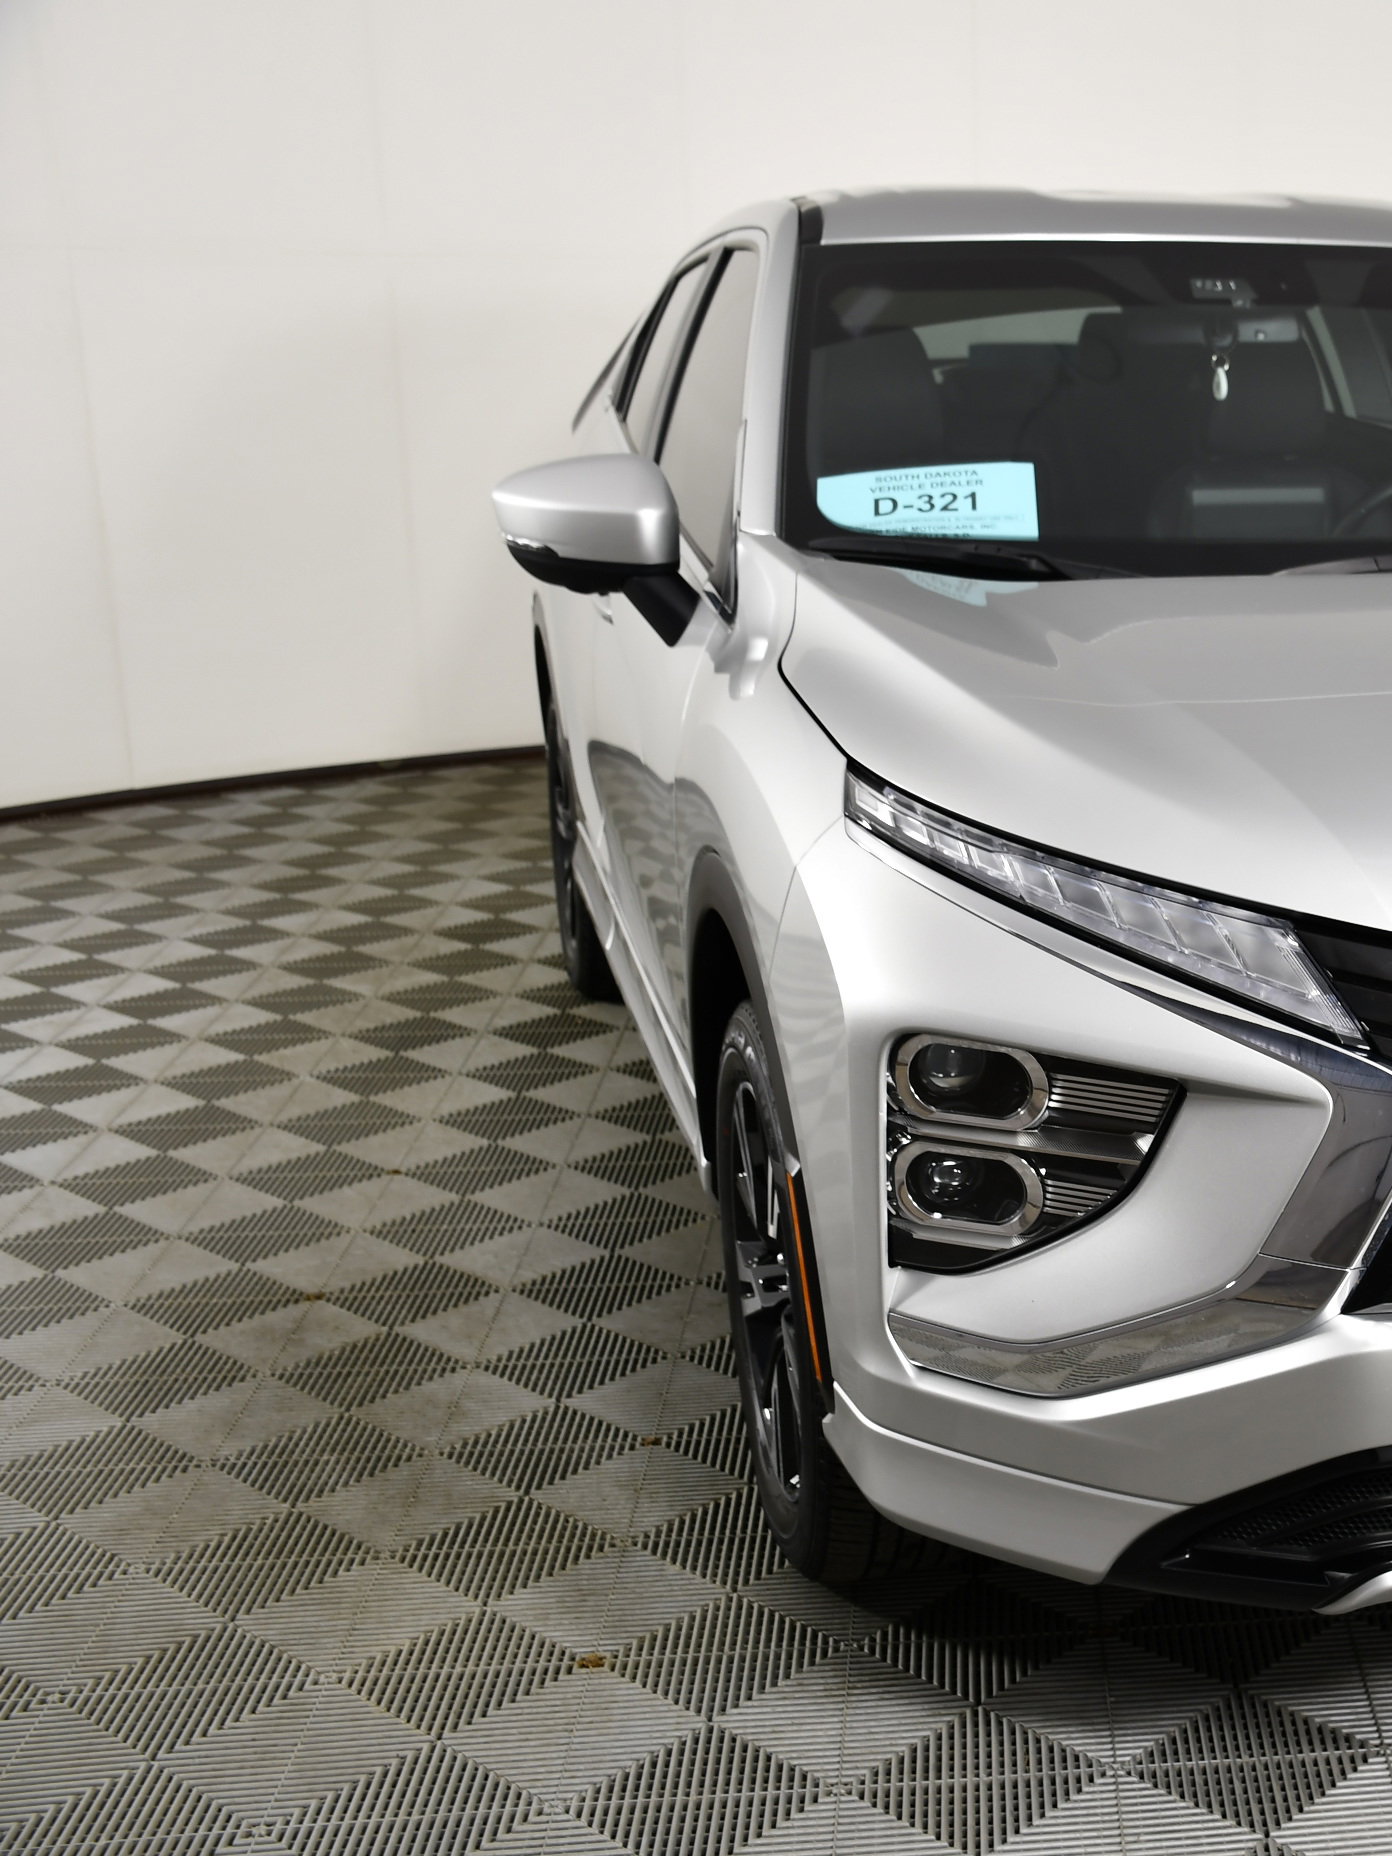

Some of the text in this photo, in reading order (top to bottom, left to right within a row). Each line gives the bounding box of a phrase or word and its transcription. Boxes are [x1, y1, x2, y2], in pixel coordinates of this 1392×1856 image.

[875, 470, 979, 483] SOUTH DAKOTA
[869, 479, 984, 493] VEHICLE DEALER
[873, 491, 978, 517] D-321
